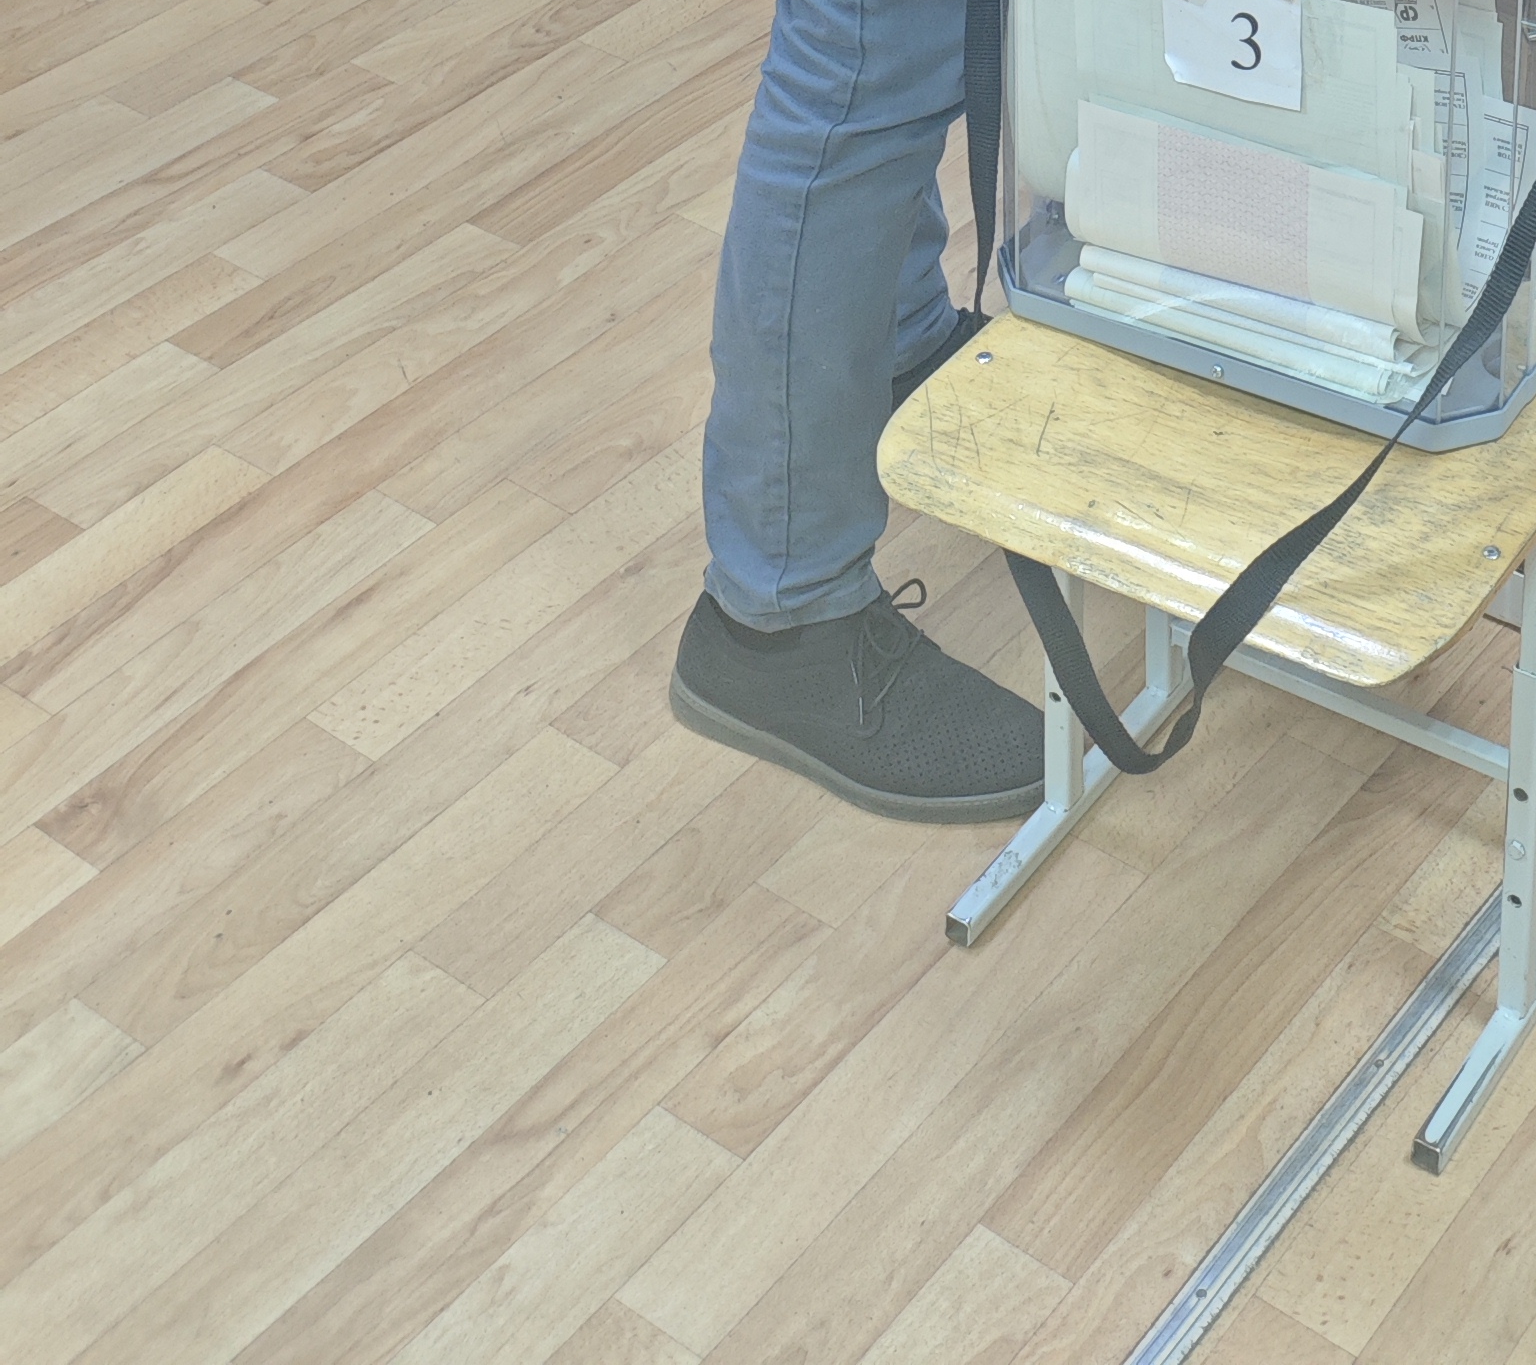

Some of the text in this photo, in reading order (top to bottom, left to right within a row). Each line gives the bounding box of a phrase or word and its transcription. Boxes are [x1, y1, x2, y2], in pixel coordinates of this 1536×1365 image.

[1400, 5, 1418, 21] СР
[1231, 12, 1262, 70] 3
[1400, 35, 1429, 43] КПРФ
